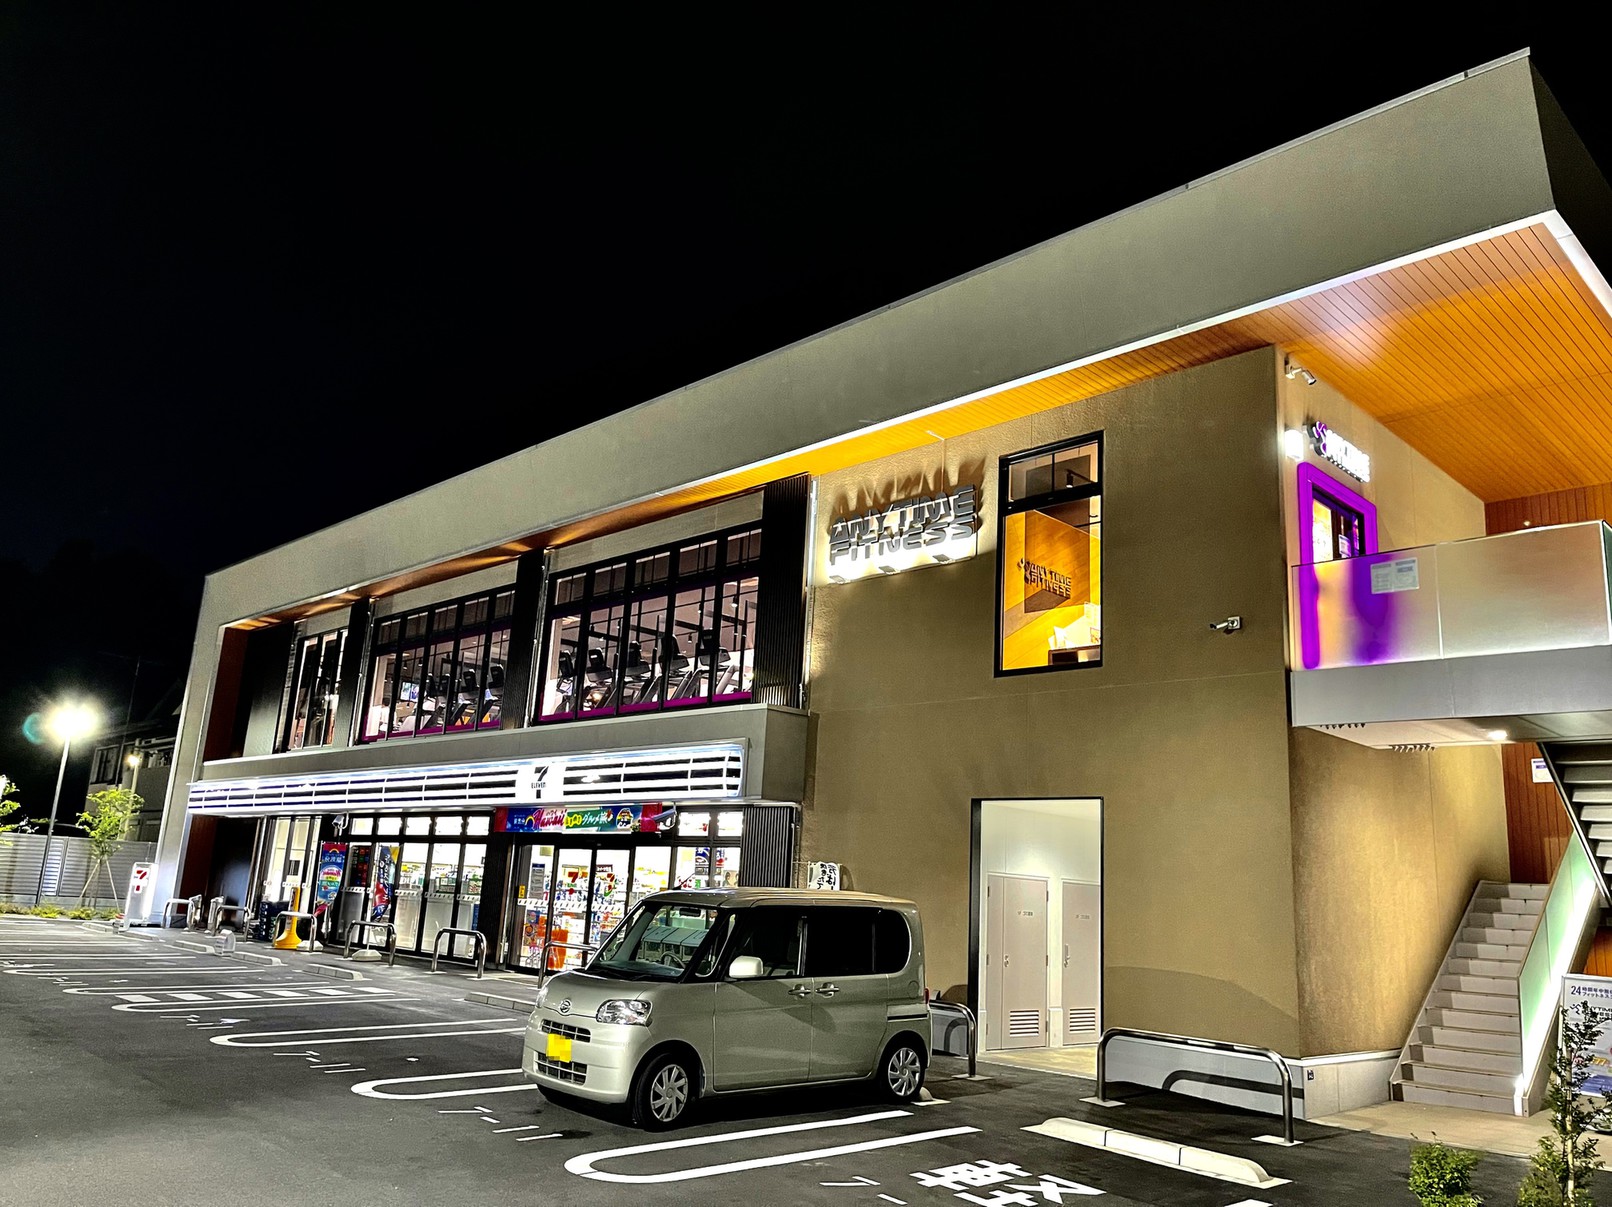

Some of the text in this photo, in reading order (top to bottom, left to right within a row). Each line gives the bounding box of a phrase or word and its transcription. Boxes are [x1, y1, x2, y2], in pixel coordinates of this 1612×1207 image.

[829, 484, 976, 544] ANYTIME
[829, 514, 976, 566] FITNESS
[534, 766, 549, 799] 7
[1571, 985, 1581, 995] 24
